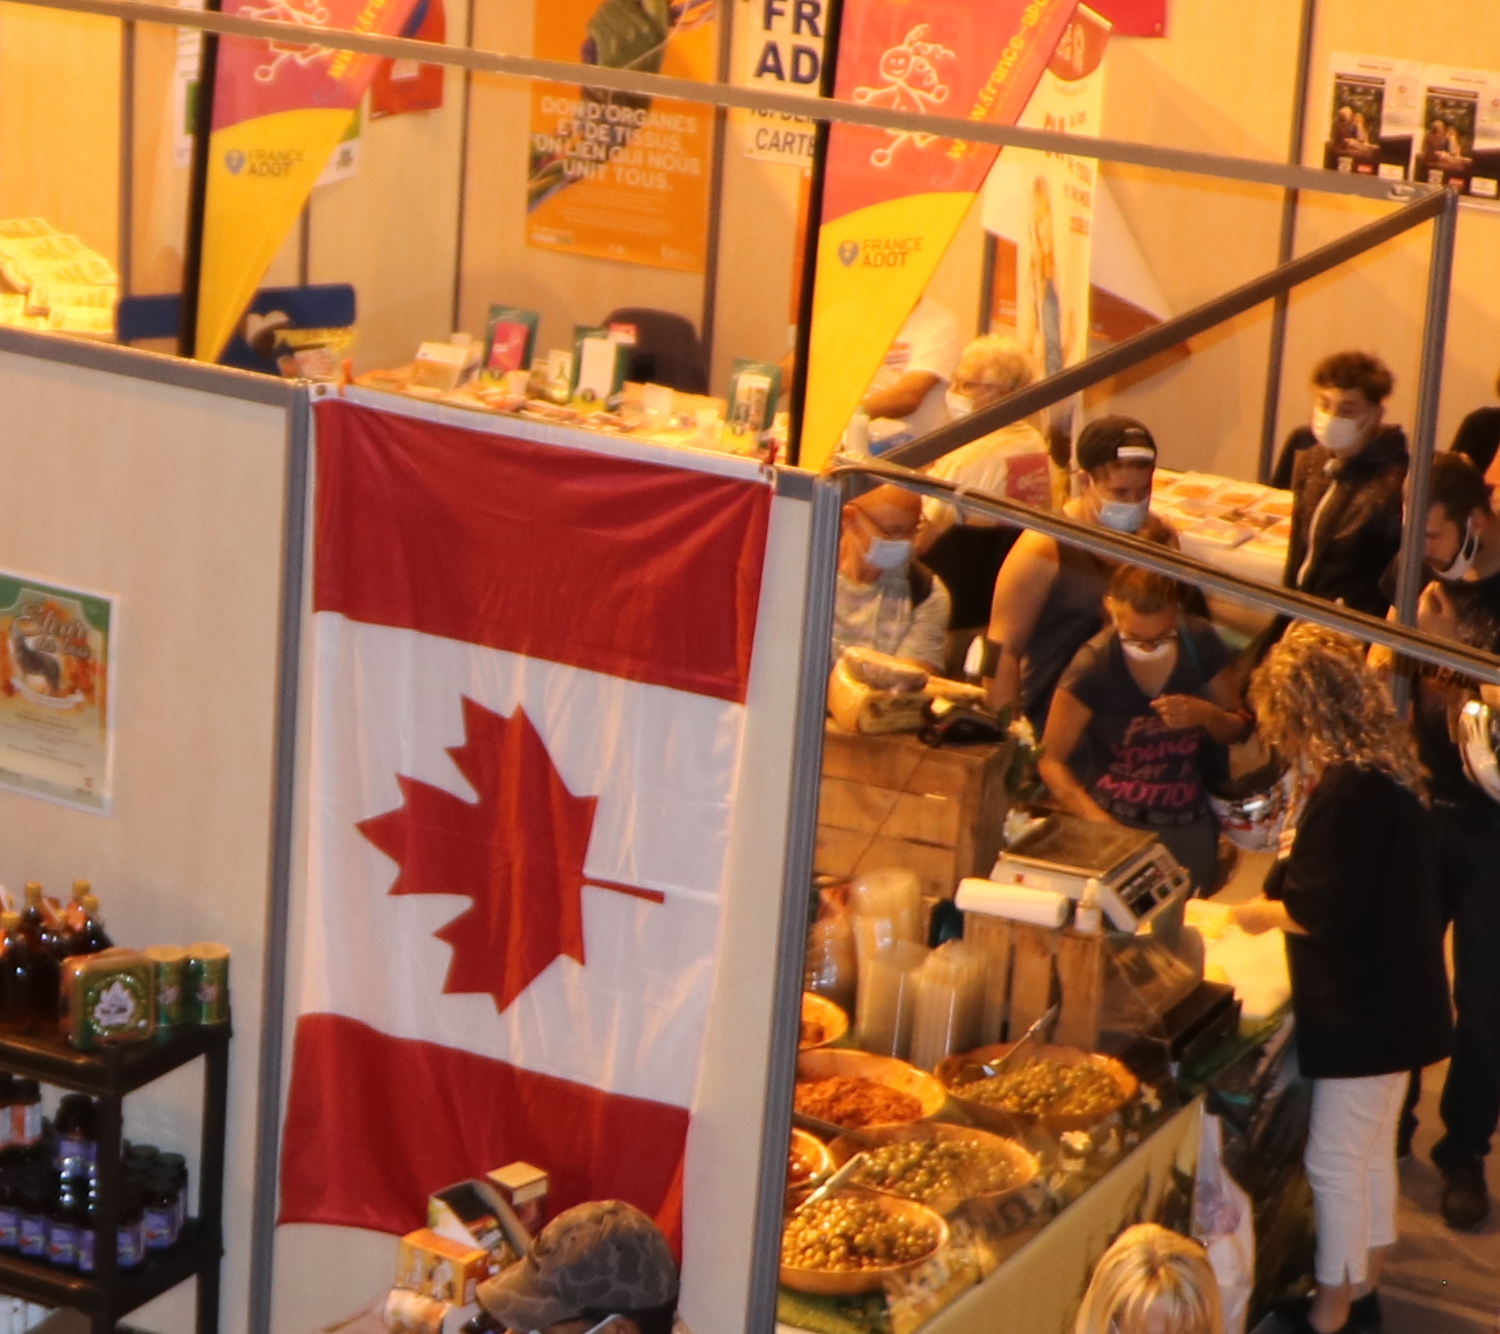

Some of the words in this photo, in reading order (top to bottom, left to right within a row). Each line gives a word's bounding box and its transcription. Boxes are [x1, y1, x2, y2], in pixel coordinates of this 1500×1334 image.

[247, 147, 307, 164] FRANCE
[862, 236, 924, 253] FRANCE
[861, 250, 910, 269] ADOT
